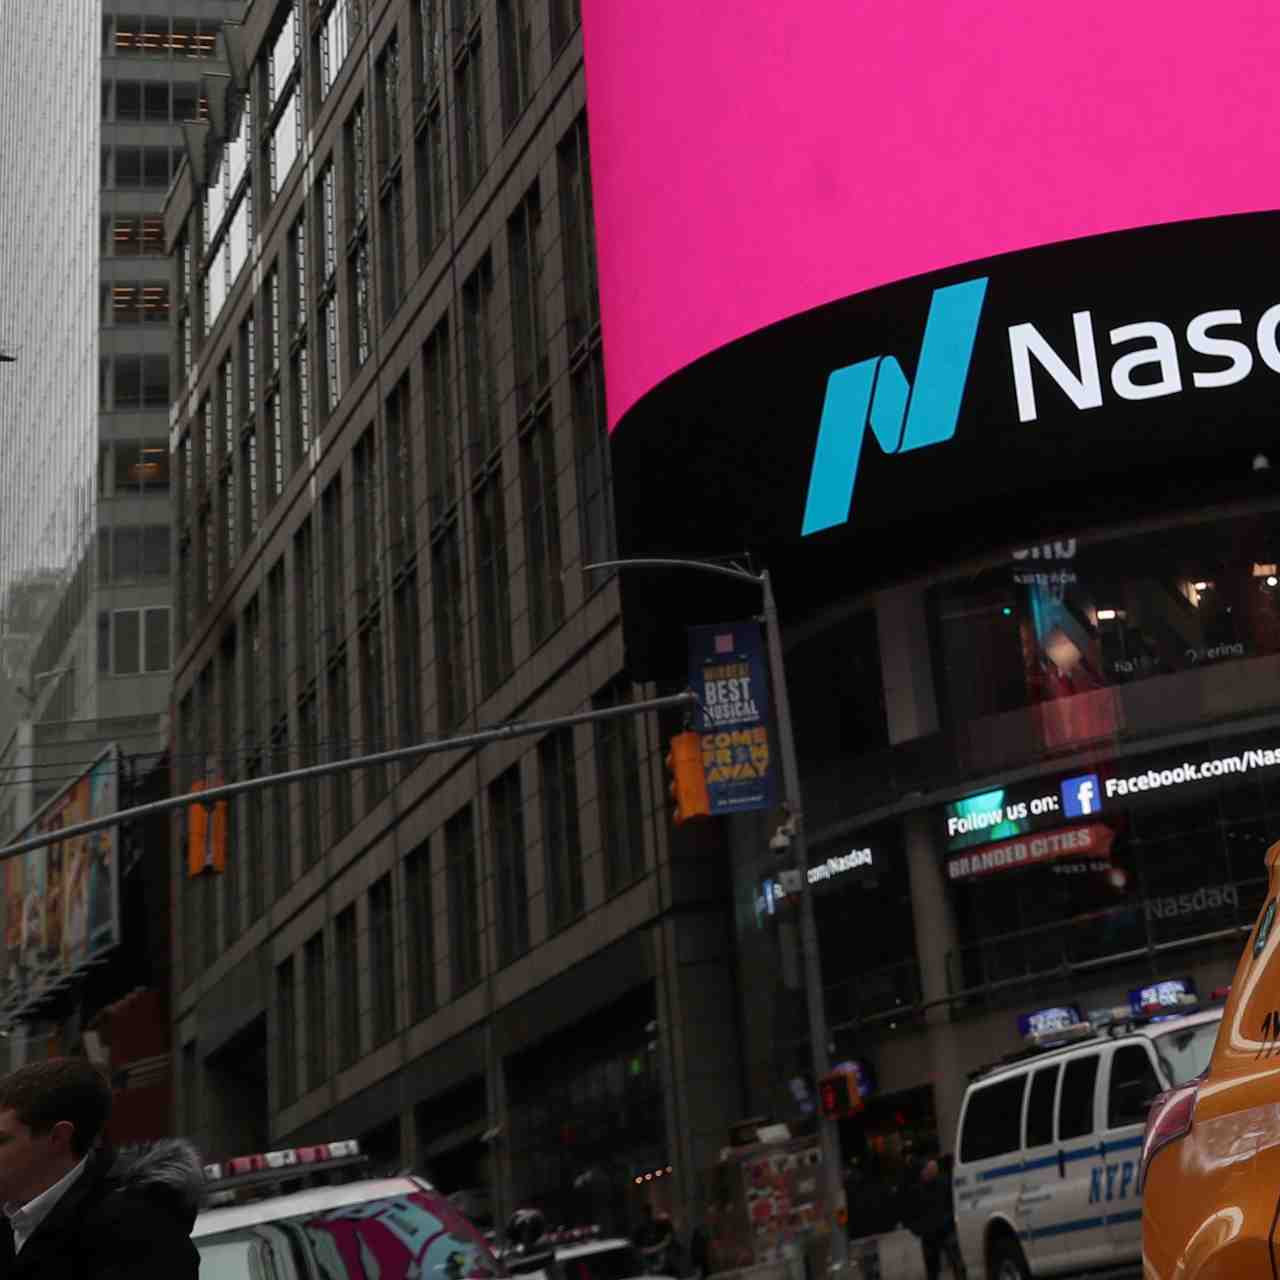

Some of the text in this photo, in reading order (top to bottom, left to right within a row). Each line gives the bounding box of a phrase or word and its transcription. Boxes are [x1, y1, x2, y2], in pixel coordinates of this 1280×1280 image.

[705, 677, 751, 706] BEST
[947, 807, 1003, 836] Follow
[1006, 801, 1028, 821] us
[1030, 794, 1060, 816] on:
[948, 841, 1026, 879] BRANDED
[1029, 826, 1091, 857] CITIES
[1143, 884, 1239, 921] Nasdaq
[1089, 1160, 1143, 1204] NYP
